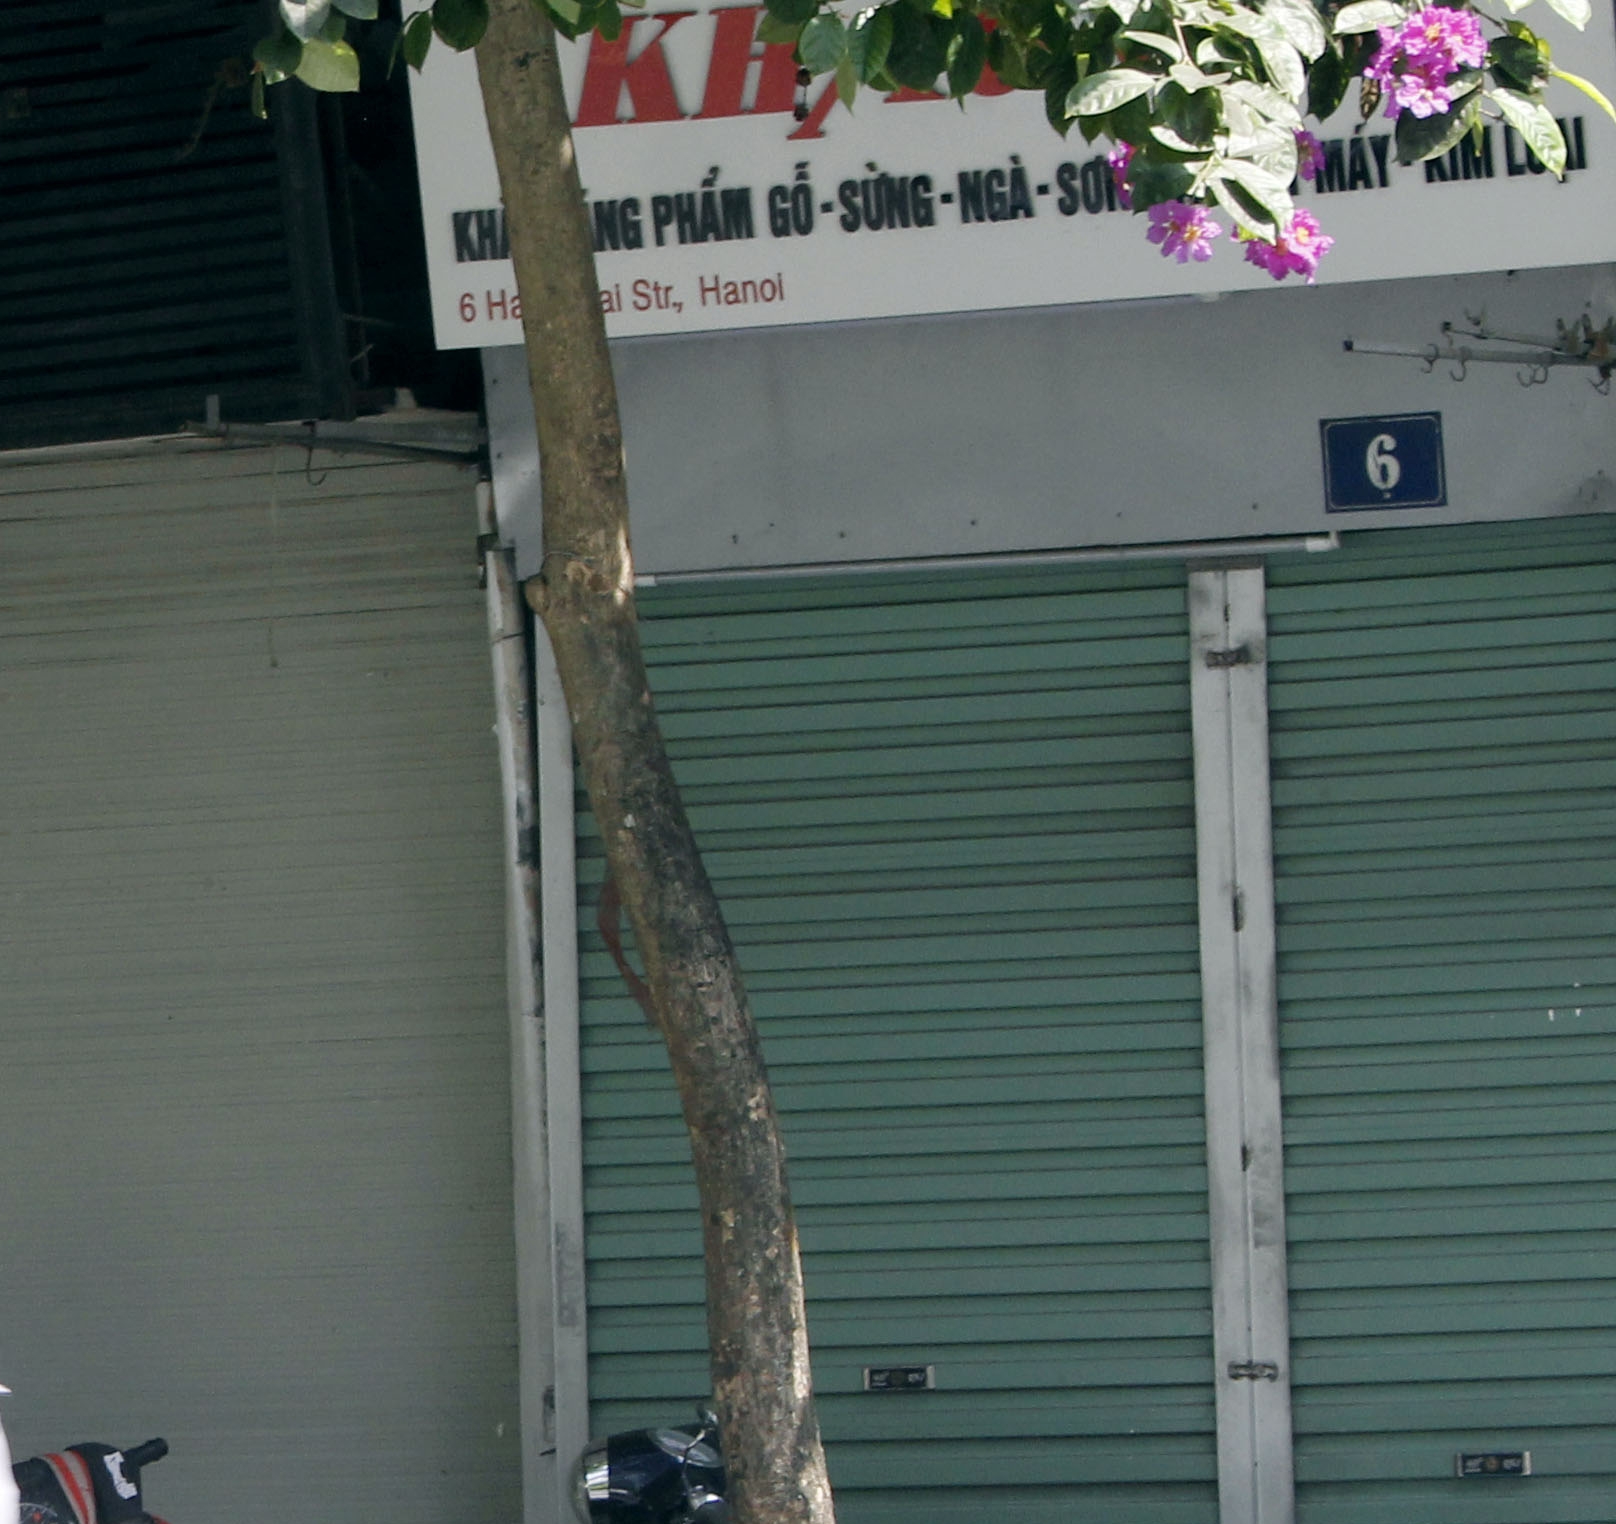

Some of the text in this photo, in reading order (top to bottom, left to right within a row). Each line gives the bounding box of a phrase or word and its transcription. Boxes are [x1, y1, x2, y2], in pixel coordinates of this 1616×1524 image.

[767, 160, 815, 238] GỖ
[958, 154, 1034, 224] NGÀ
[459, 293, 477, 323] 6
[698, 272, 785, 308] Hanoi
[1366, 433, 1401, 491] 6
